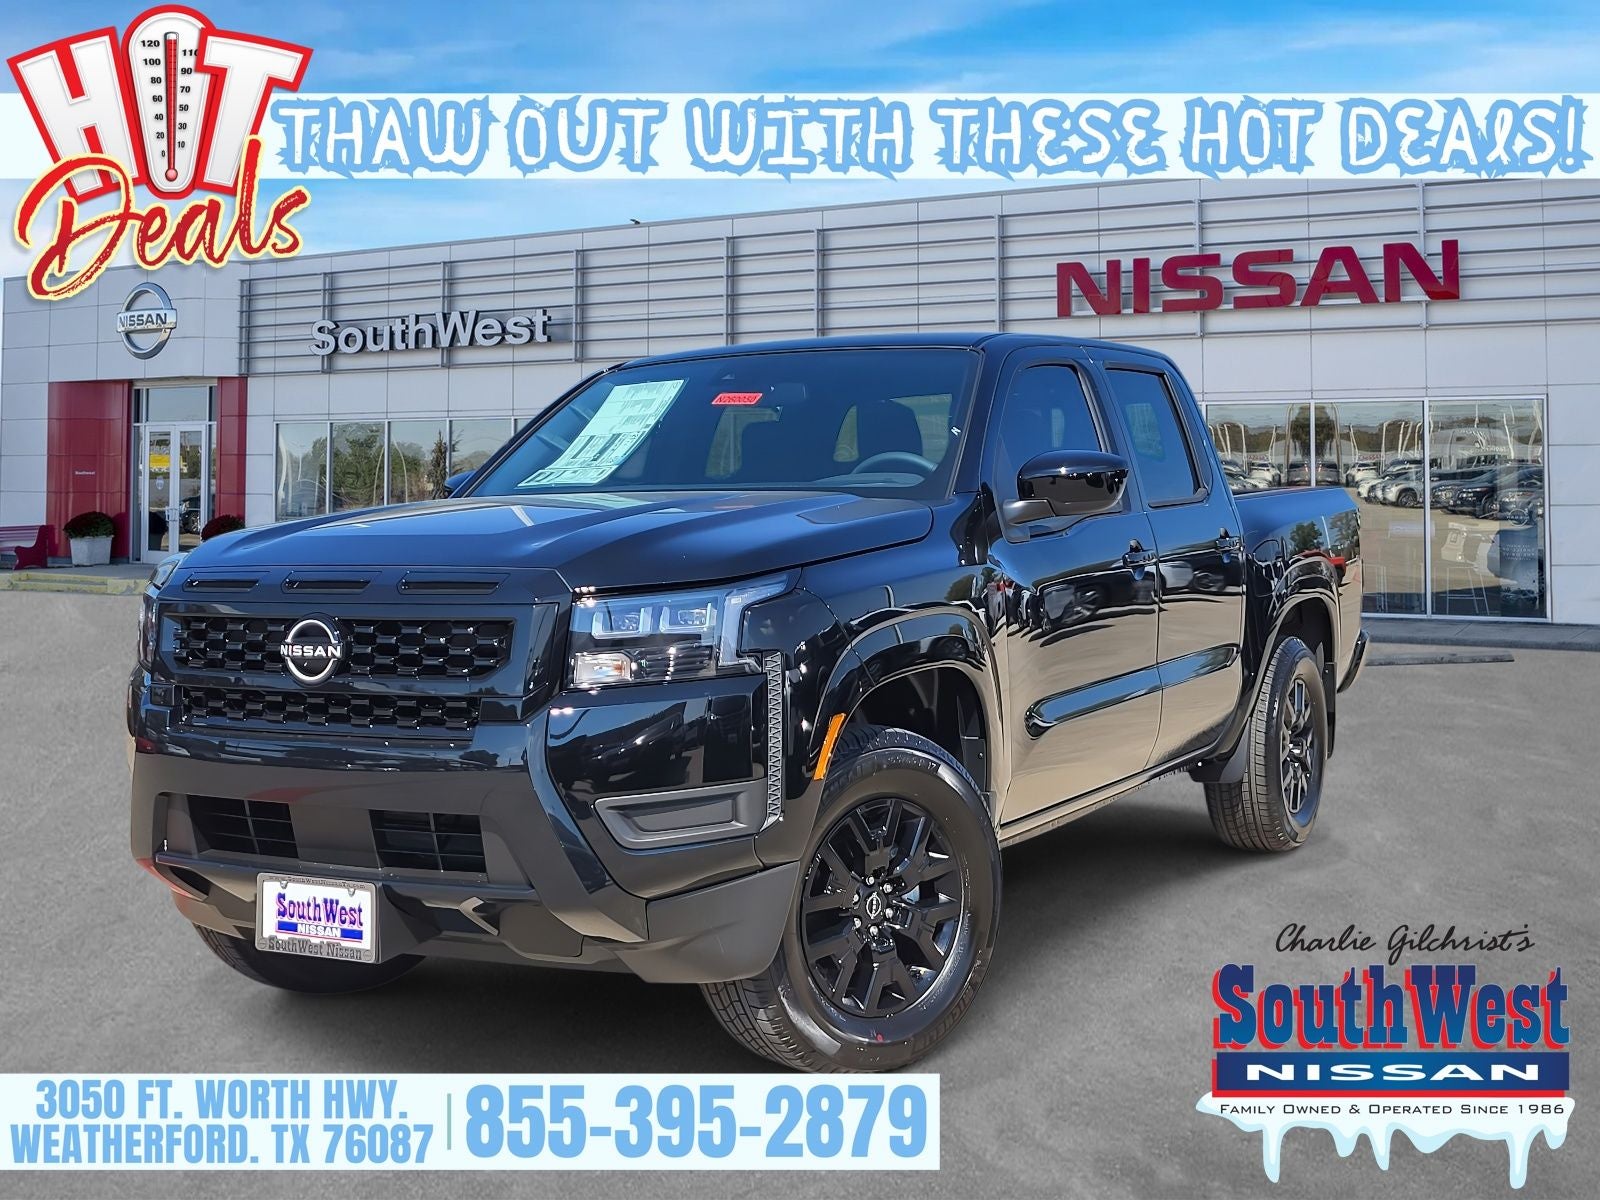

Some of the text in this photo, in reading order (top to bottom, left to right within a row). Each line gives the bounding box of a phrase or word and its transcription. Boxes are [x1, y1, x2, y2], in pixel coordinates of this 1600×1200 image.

[1057, 239, 1460, 317] NISSAN
[119, 312, 168, 328] NISSAN
[310, 308, 552, 356] SouthWest
[280, 644, 341, 657] NISSAN
[276, 893, 363, 927] SouthWest
[297, 923, 341, 938] NISSAN
[268, 935, 362, 960] SouthWest Nissan
